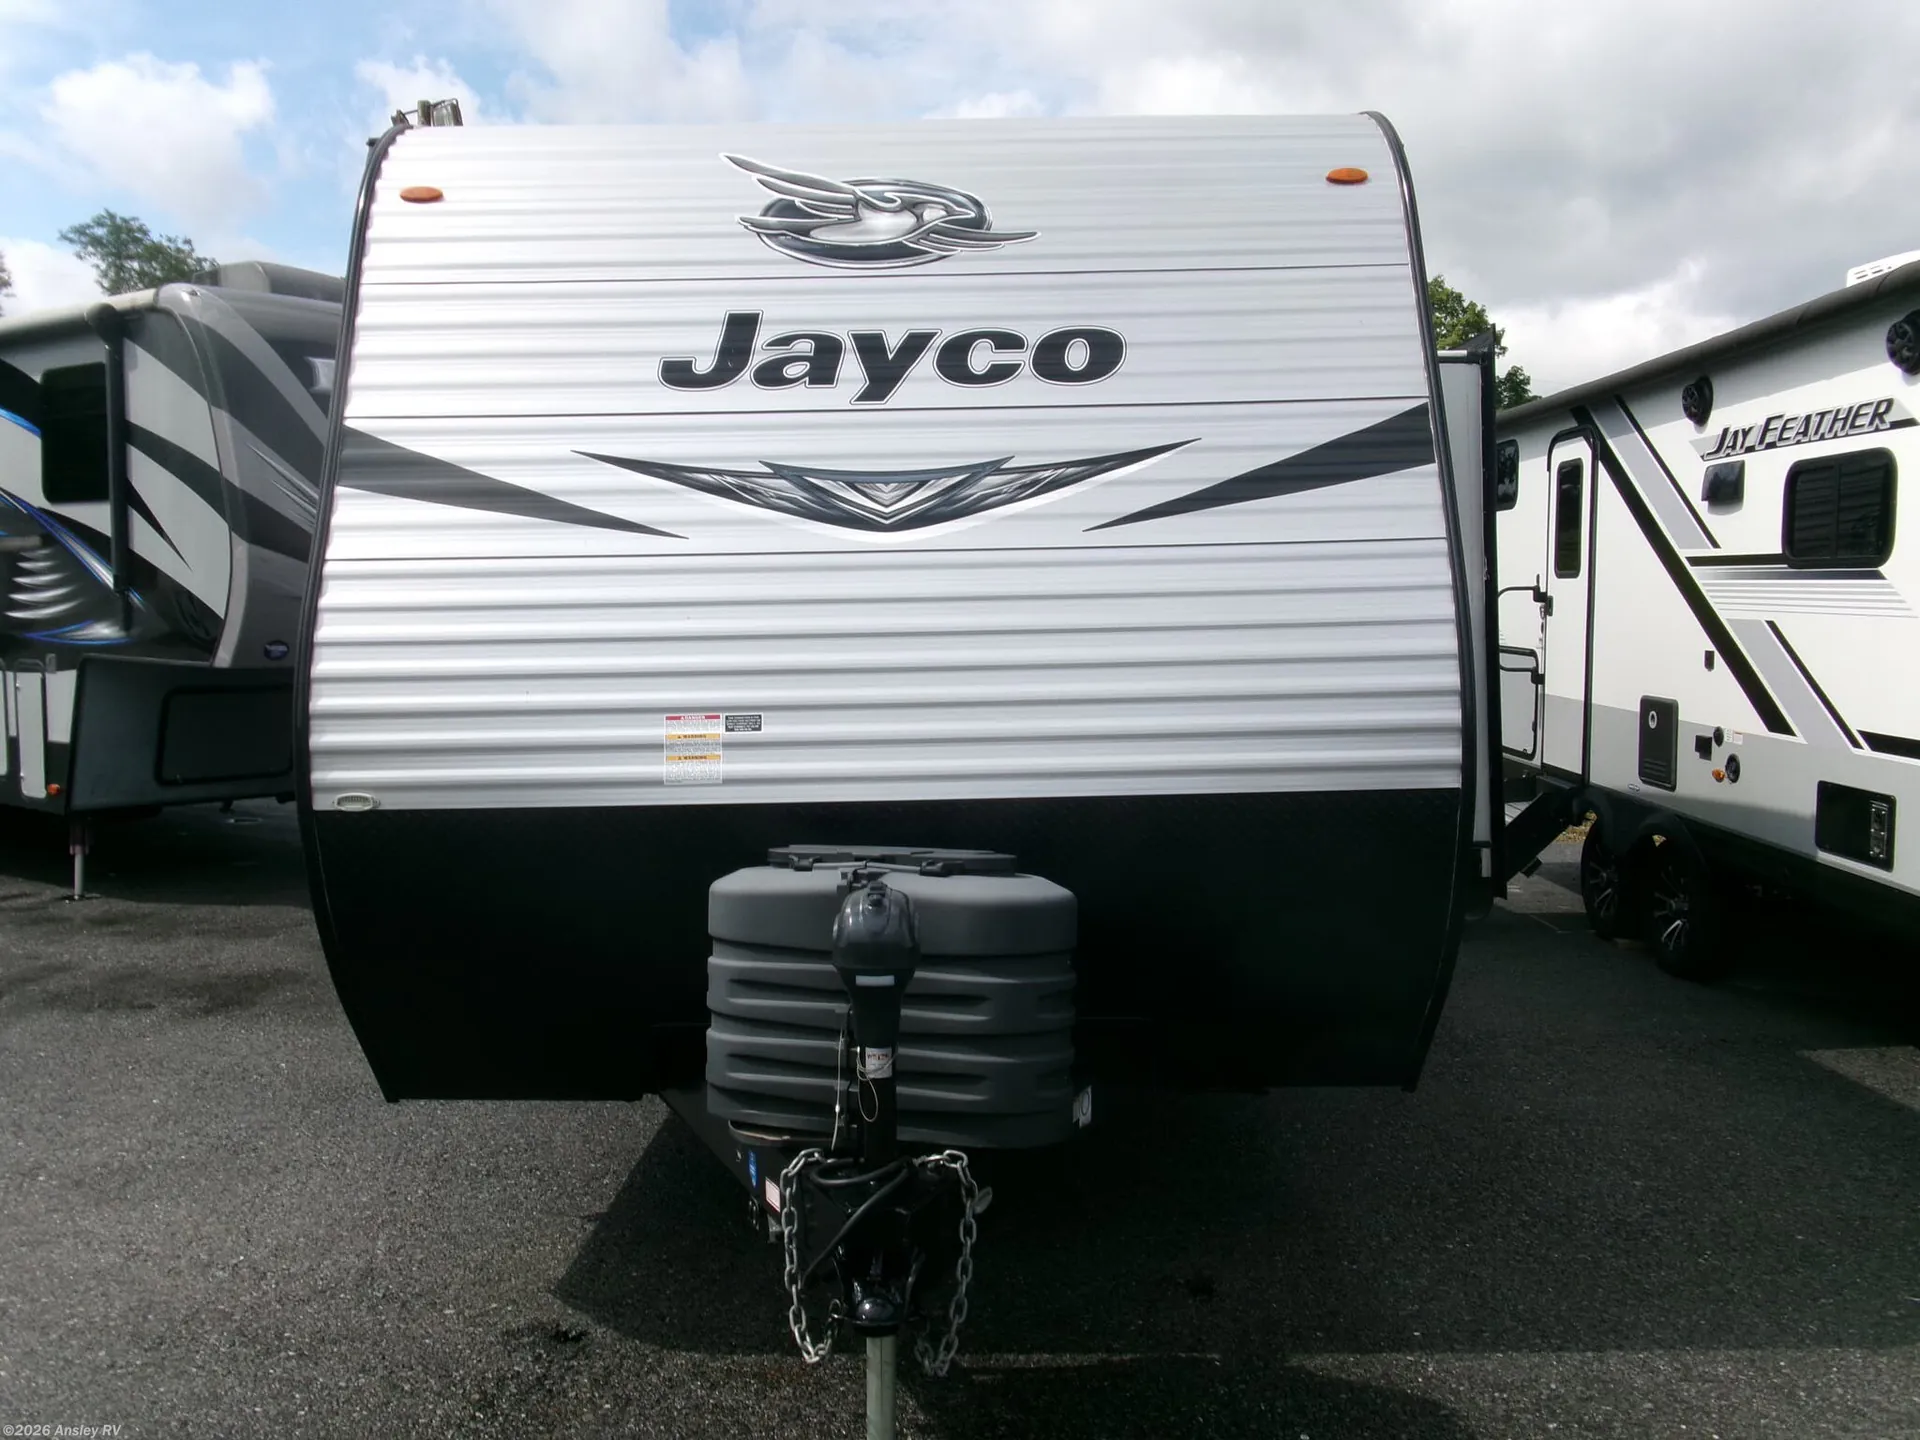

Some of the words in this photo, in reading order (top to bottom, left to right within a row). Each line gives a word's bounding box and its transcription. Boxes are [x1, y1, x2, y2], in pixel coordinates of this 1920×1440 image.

[658, 309, 1127, 404] Jayco
[1704, 425, 1755, 460] JAY
[1755, 397, 1895, 450] FEATHER
